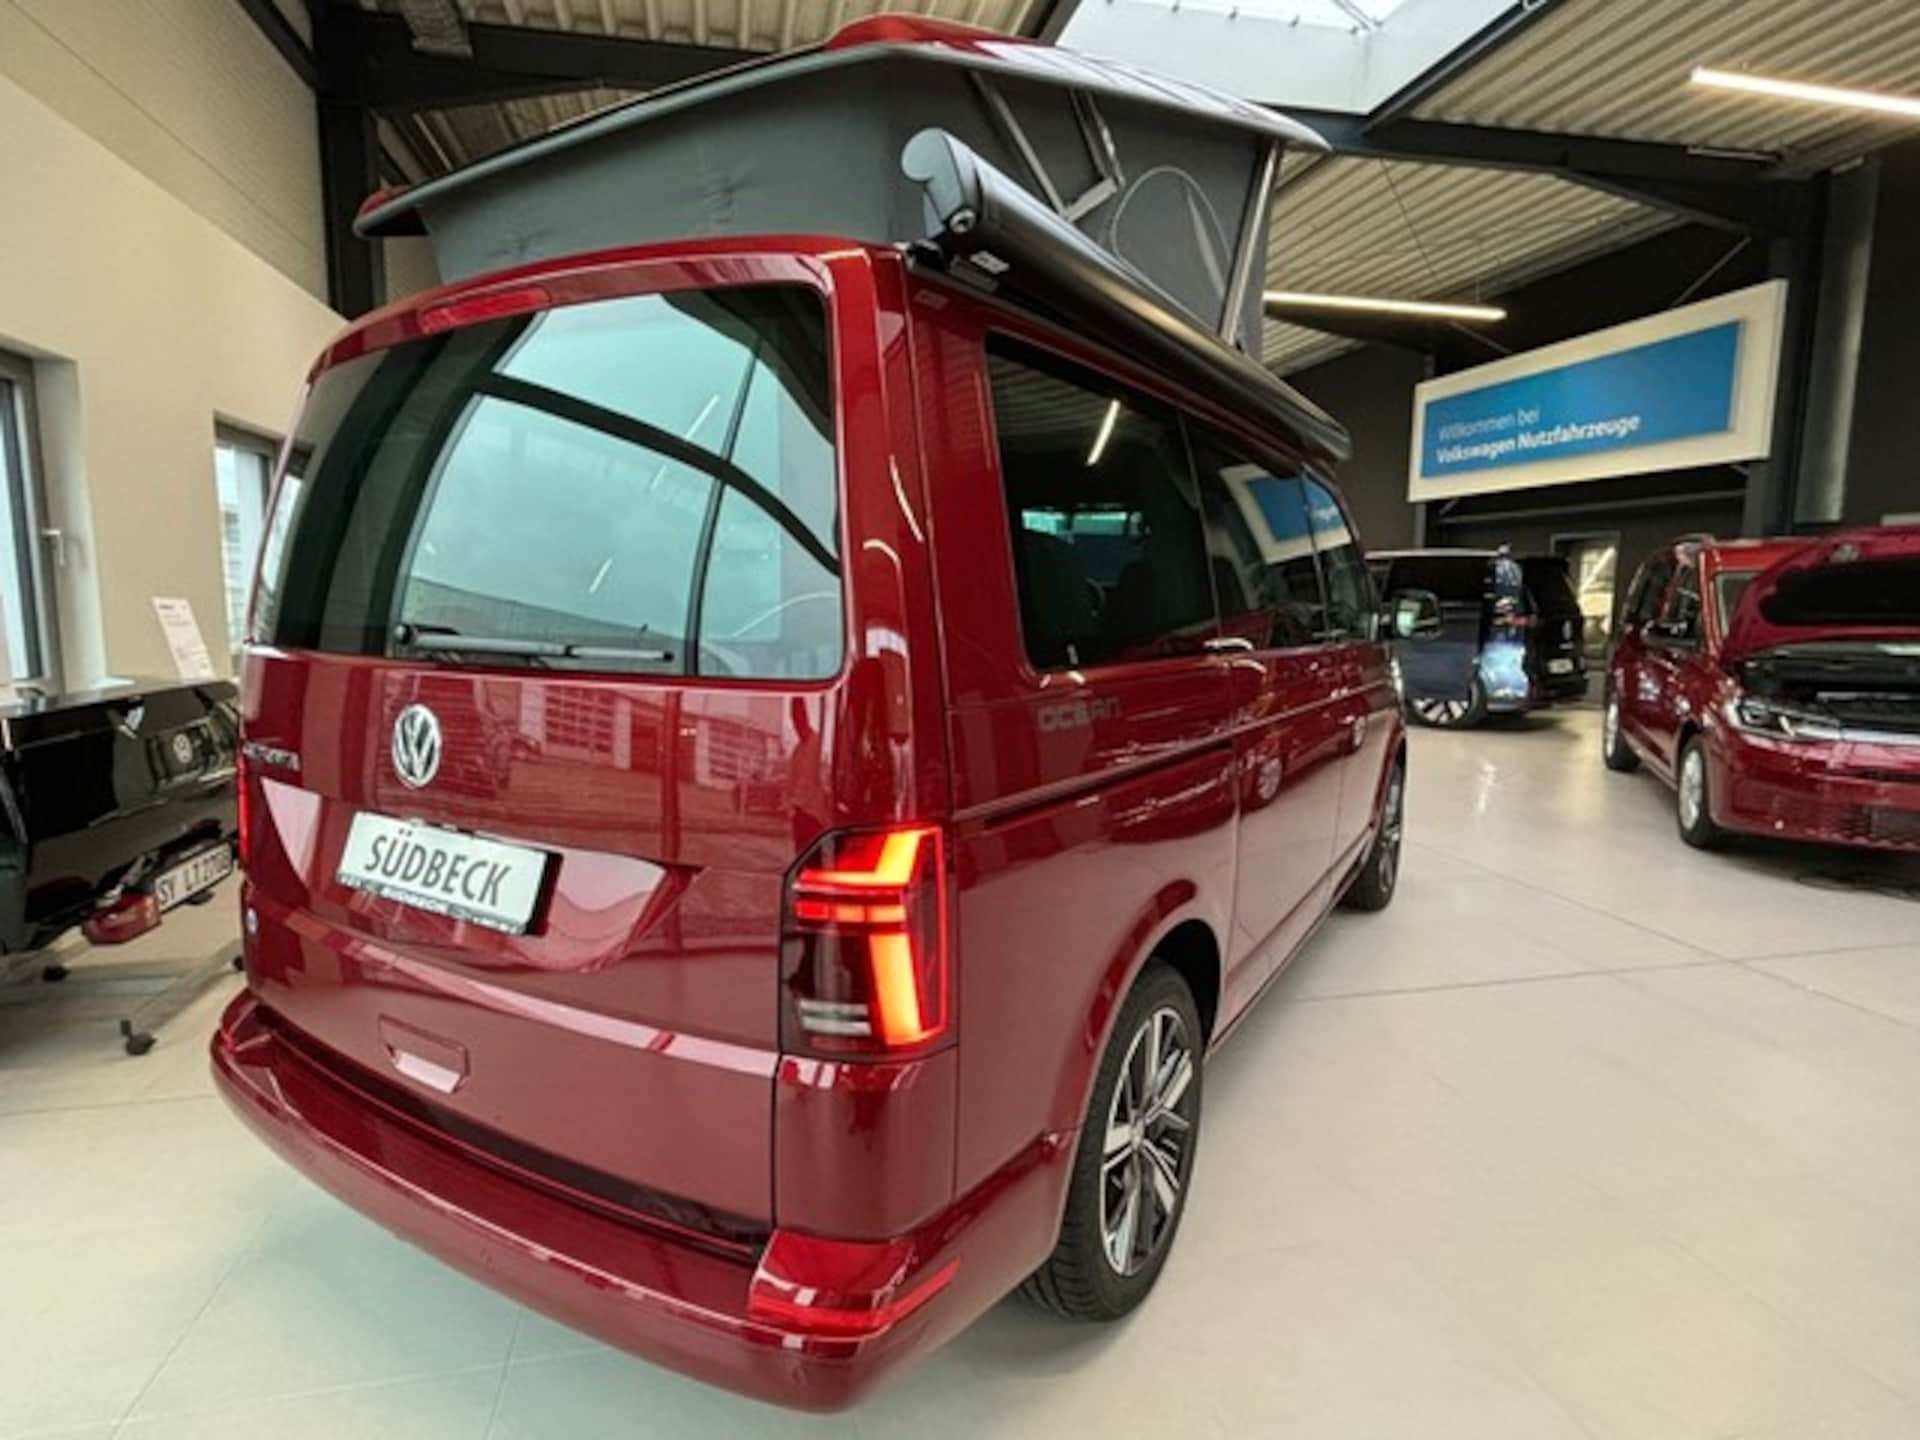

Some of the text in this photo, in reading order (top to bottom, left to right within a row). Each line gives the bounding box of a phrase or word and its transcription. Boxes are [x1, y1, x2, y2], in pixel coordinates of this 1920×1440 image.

[1435, 414, 1642, 465] Volkswagen Nutzfahrzeuge
[1438, 407, 1541, 442] Willkommen bei
[365, 828, 511, 907] SÜDBECK
